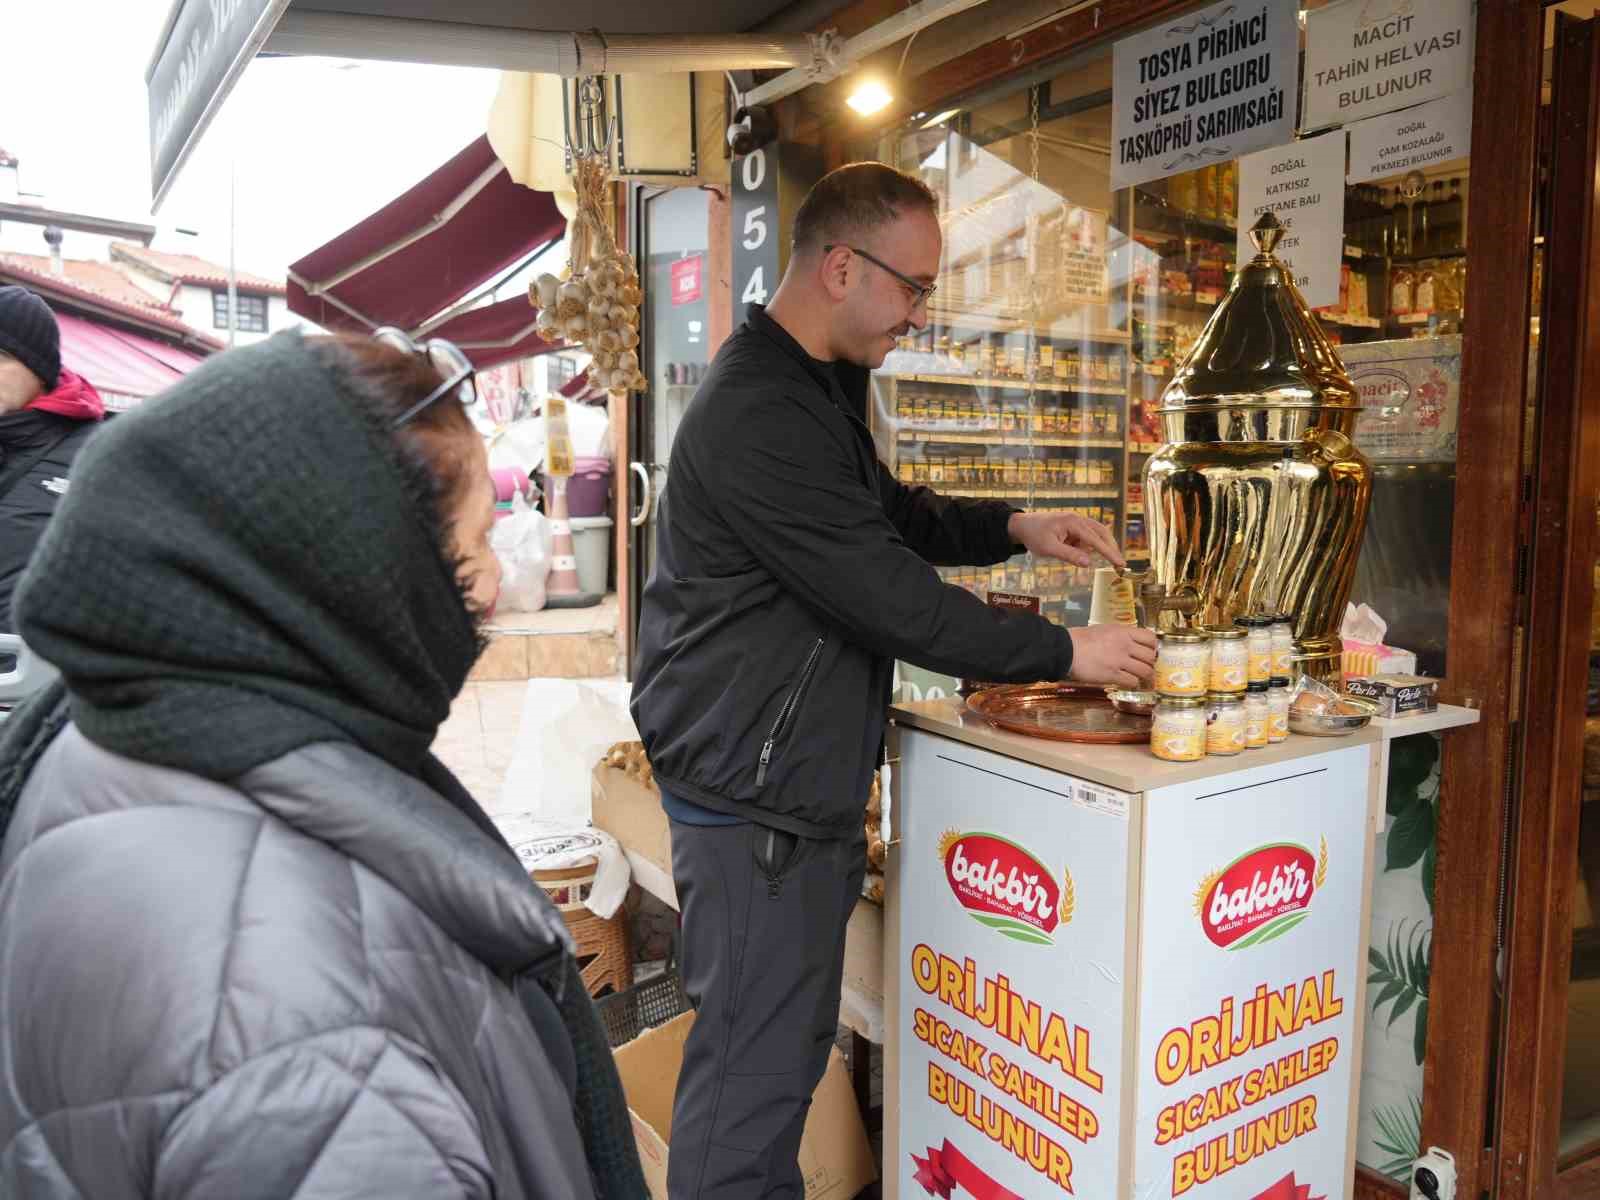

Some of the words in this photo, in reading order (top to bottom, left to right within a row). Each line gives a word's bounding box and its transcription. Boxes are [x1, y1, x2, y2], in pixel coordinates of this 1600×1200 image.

[1138, 42, 1192, 84] TOSYA
[1197, 6, 1268, 65] PİRİNCİ
[1315, 57, 1369, 87] TAHİN
[1375, 29, 1462, 70] HELVASI
[1353, 15, 1415, 49] MACİT
[1120, 114, 1192, 165] TAŞKÖPRÜ
[1196, 86, 1284, 144] SARIMSAĞI
[1134, 84, 1181, 123] SİYEZ
[1185, 53, 1271, 108] BULGURU
[1338, 68, 1433, 109] BULUNUR
[1265, 177, 1311, 196] KATKISIZ
[1270, 157, 1308, 175] DOĞAL
[1299, 193, 1321, 207] BALI
[911, 943, 1104, 1095] ORİJİNAL
[1155, 968, 1344, 1086] ORİJİNAL
[913, 1007, 988, 1081] SICAK
[987, 1052, 1100, 1144] SAHLEP
[1154, 1075, 1243, 1146] SICAK
[1241, 1036, 1339, 1107] SAHLEP
[928, 1060, 1075, 1196] BULUNUR
[1171, 1094, 1318, 1199] BULUNUR
